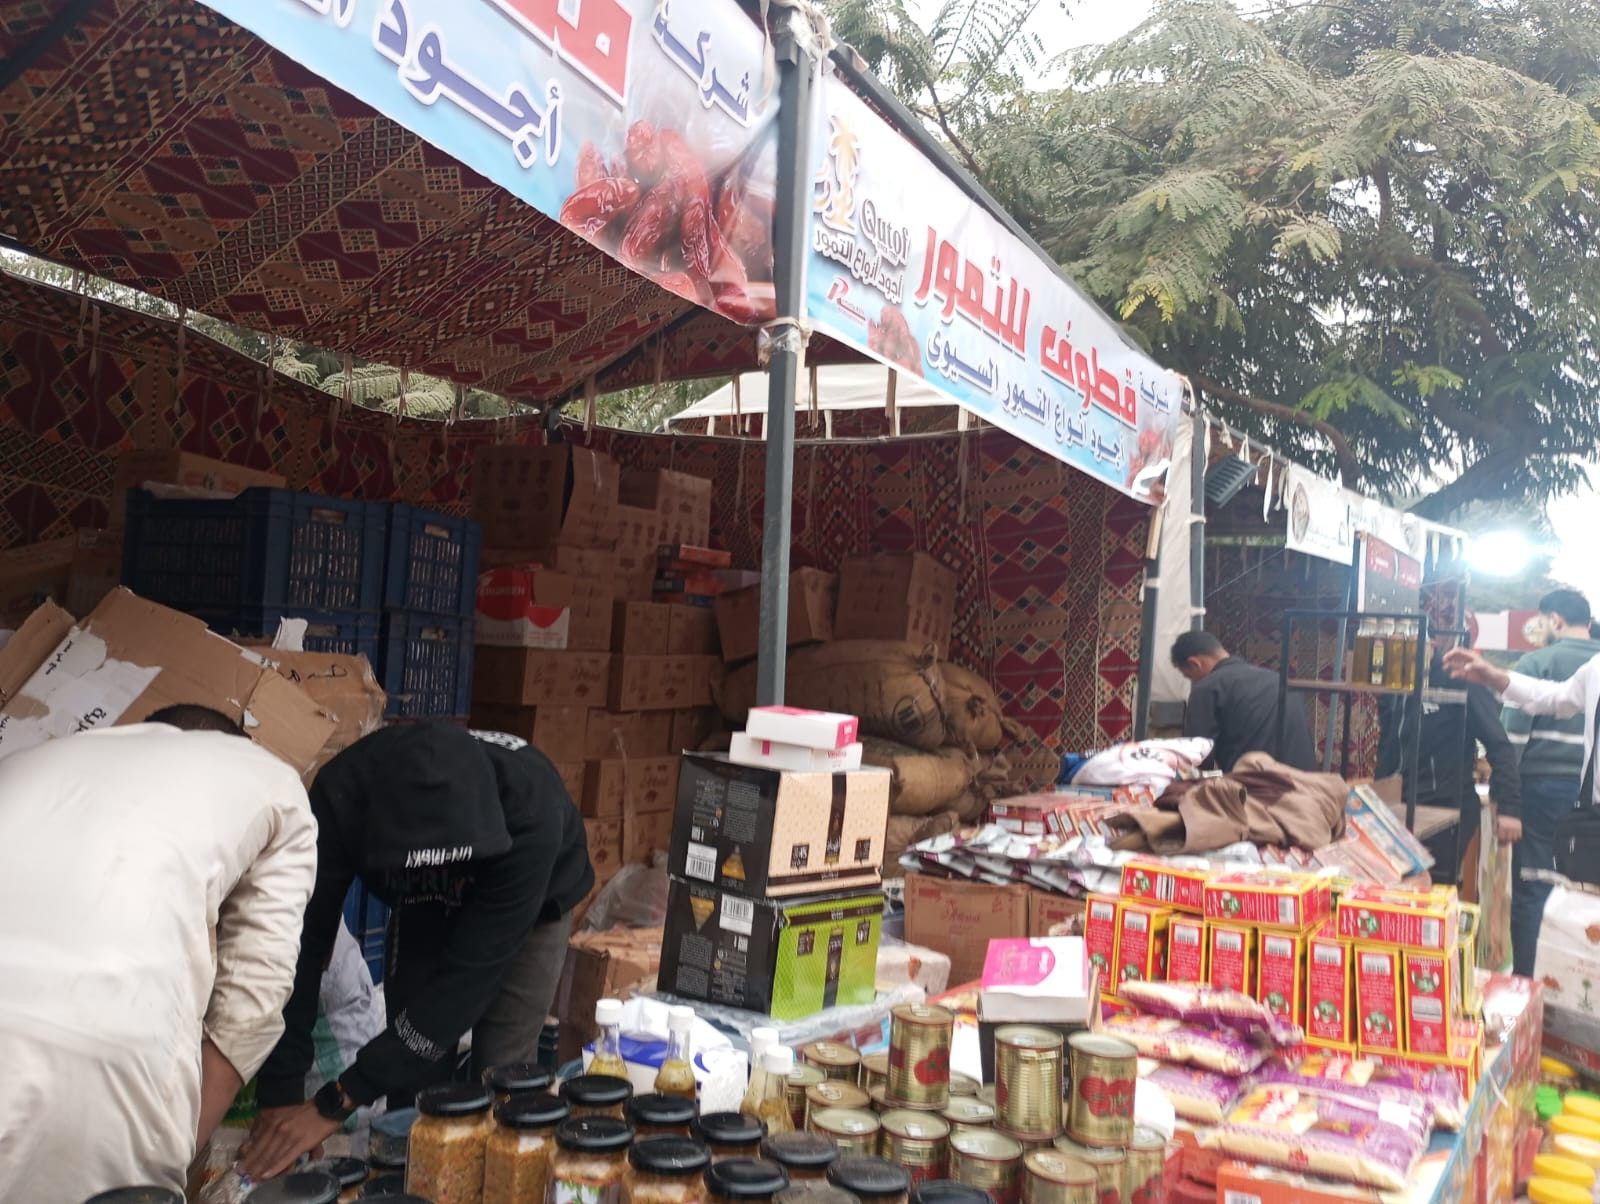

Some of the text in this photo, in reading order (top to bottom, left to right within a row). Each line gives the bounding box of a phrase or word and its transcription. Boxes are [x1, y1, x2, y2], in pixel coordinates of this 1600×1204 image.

[379, 0, 560, 162] أجود
[815, 230, 853, 260] التمور
[862, 198, 909, 260] Qutof
[915, 226, 1138, 425] قطوف للتمور
